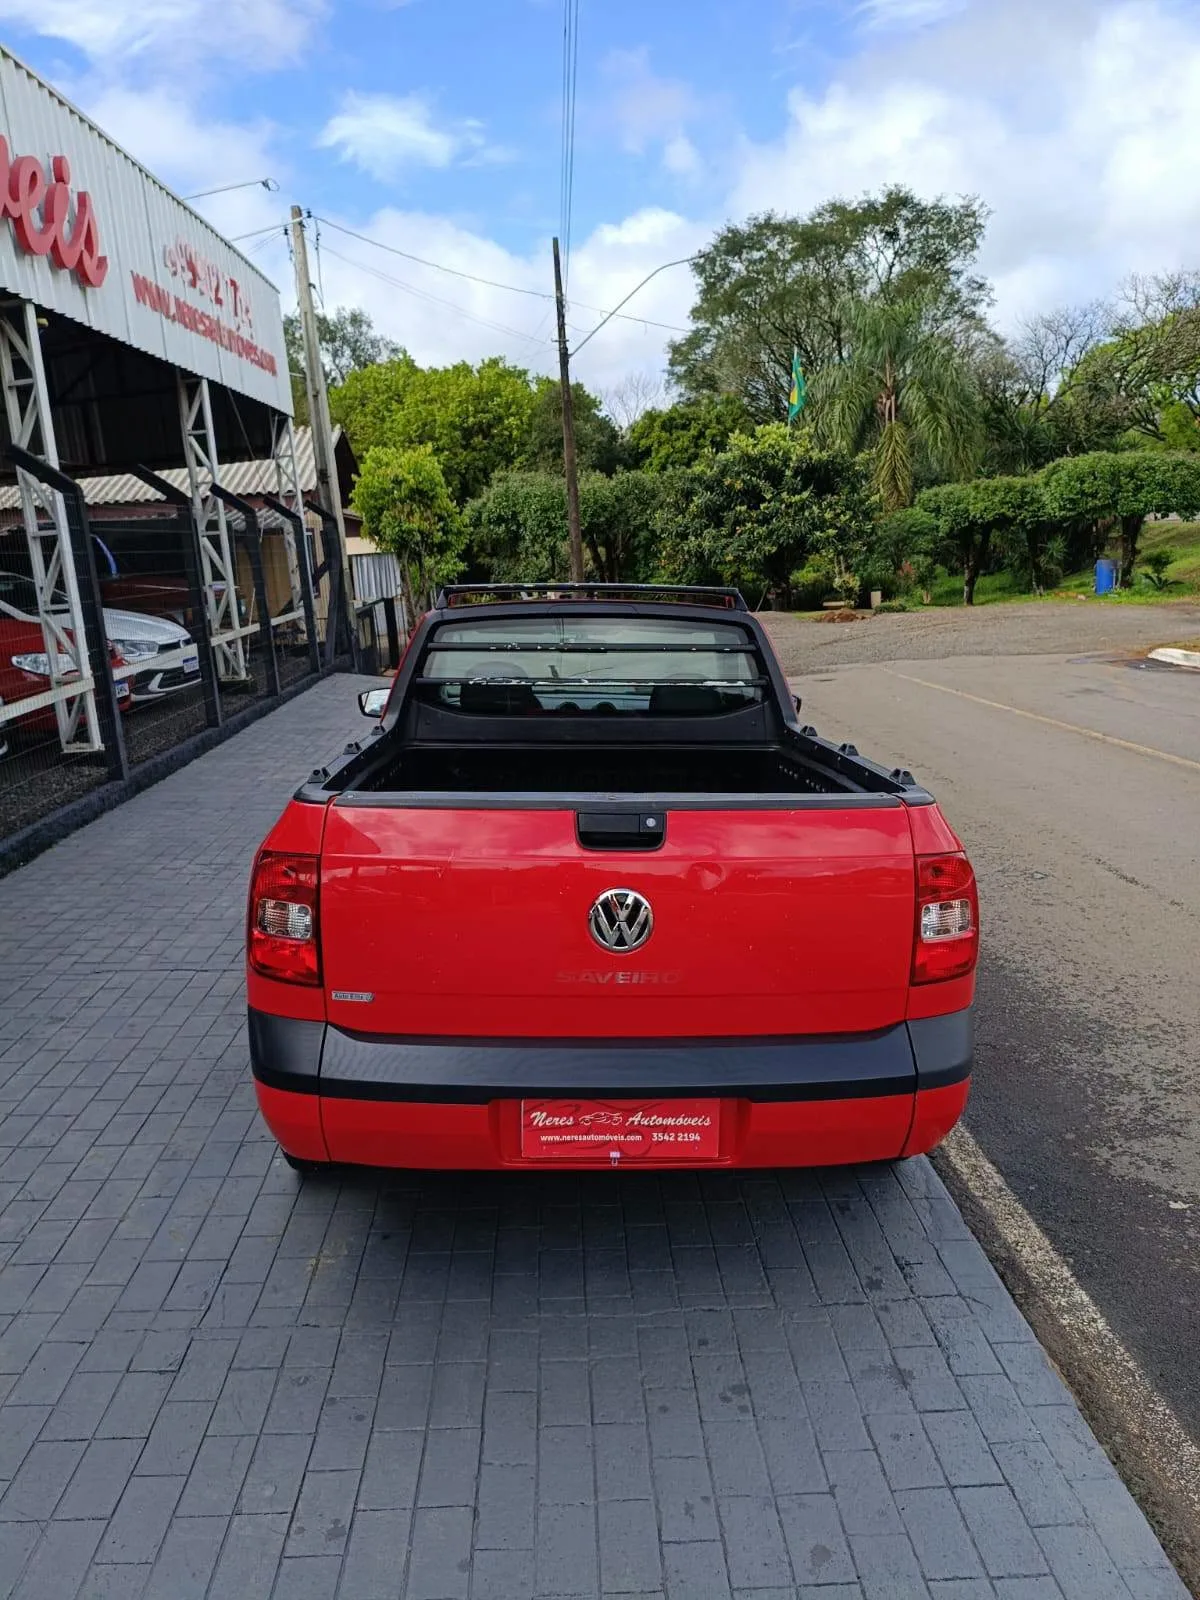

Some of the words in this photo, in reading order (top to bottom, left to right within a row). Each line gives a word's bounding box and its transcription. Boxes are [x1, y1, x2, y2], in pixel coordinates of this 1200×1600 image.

[556, 969, 682, 984] SAVEIRO
[530, 1111, 574, 1126] Neres
[625, 1111, 711, 1127] Automóveis
[540, 1132, 642, 1142] www.neresautomóveis.com
[651, 1132, 675, 1142] 3542
[677, 1132, 701, 1142] 2194
